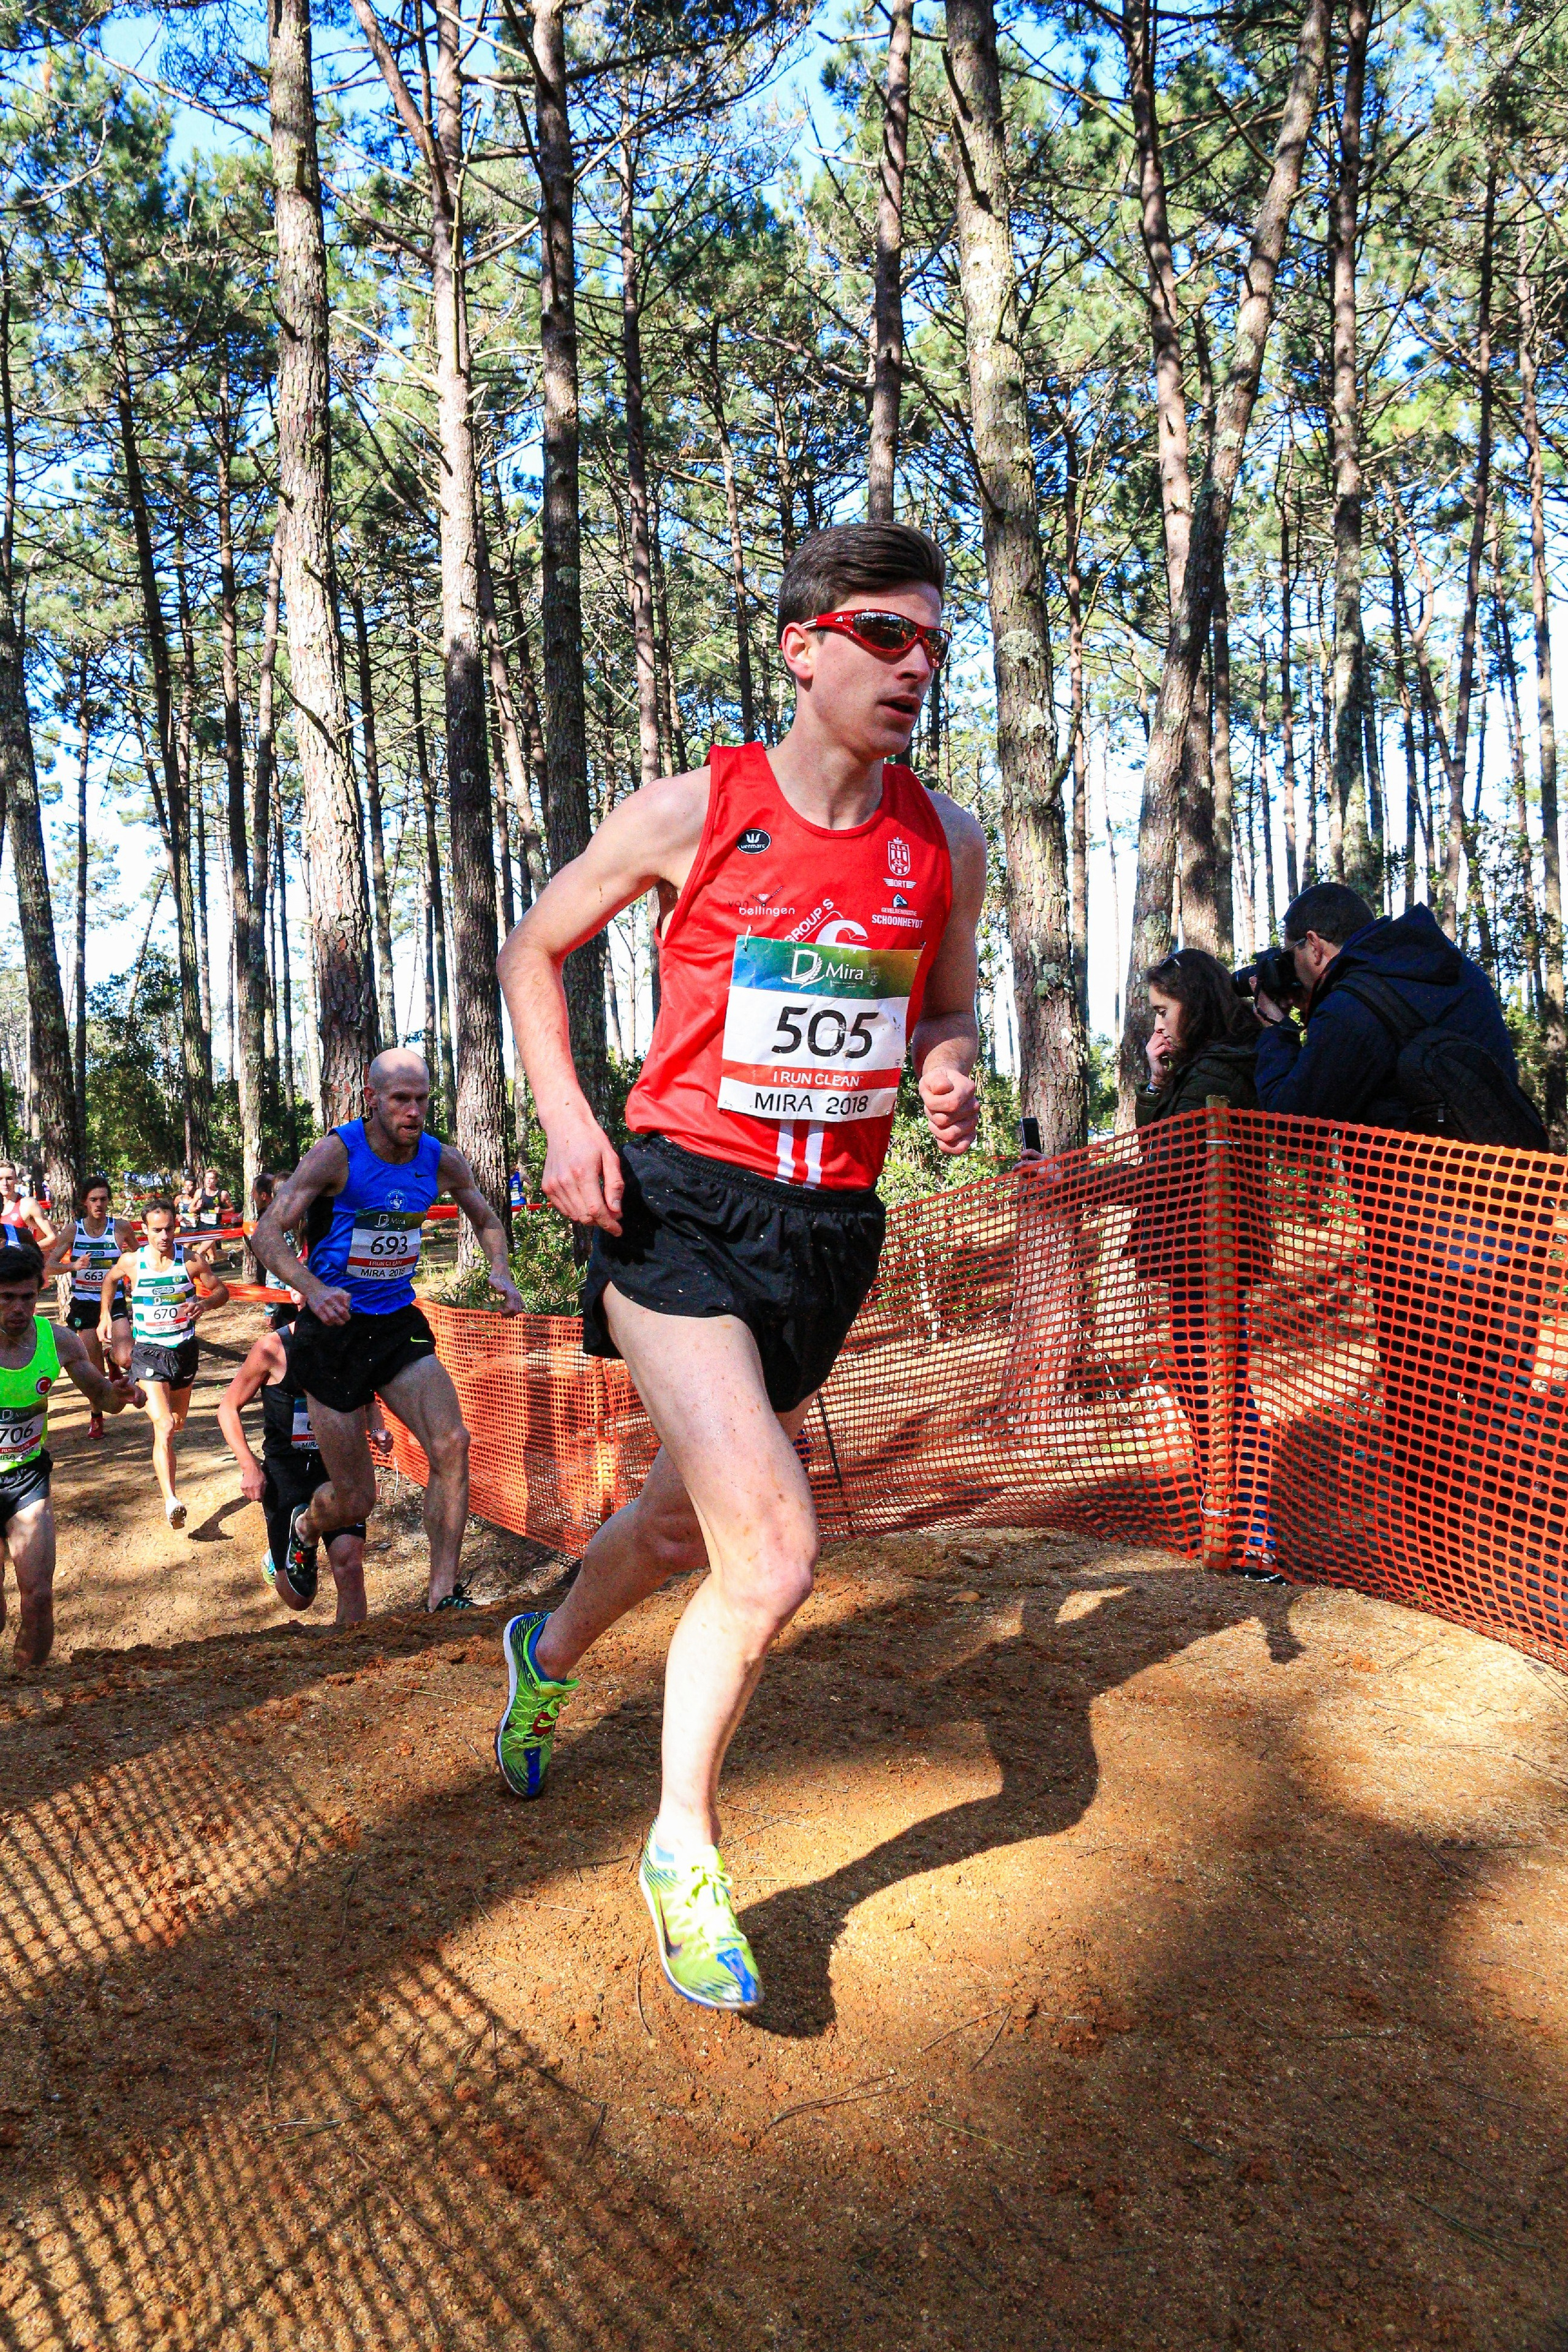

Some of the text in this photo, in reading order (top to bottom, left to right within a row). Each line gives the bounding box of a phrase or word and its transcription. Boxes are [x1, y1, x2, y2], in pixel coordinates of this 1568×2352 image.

[739, 906, 795, 917] bellingen
[784, 907, 823, 942] GROUP
[872, 914, 924, 929] SCHOONHEYDT
[826, 962, 864, 980] Mira
[771, 1006, 879, 1058] 505
[773, 1071, 859, 1087] I RUN CLEAN
[755, 1092, 869, 1115] MIRA 2018
[371, 1235, 408, 1255] 693
[85, 1272, 104, 1281] 663
[389, 1267, 405, 1277] 2018
[154, 1308, 178, 1319] 670
[0, 1420, 33, 1444] 706
